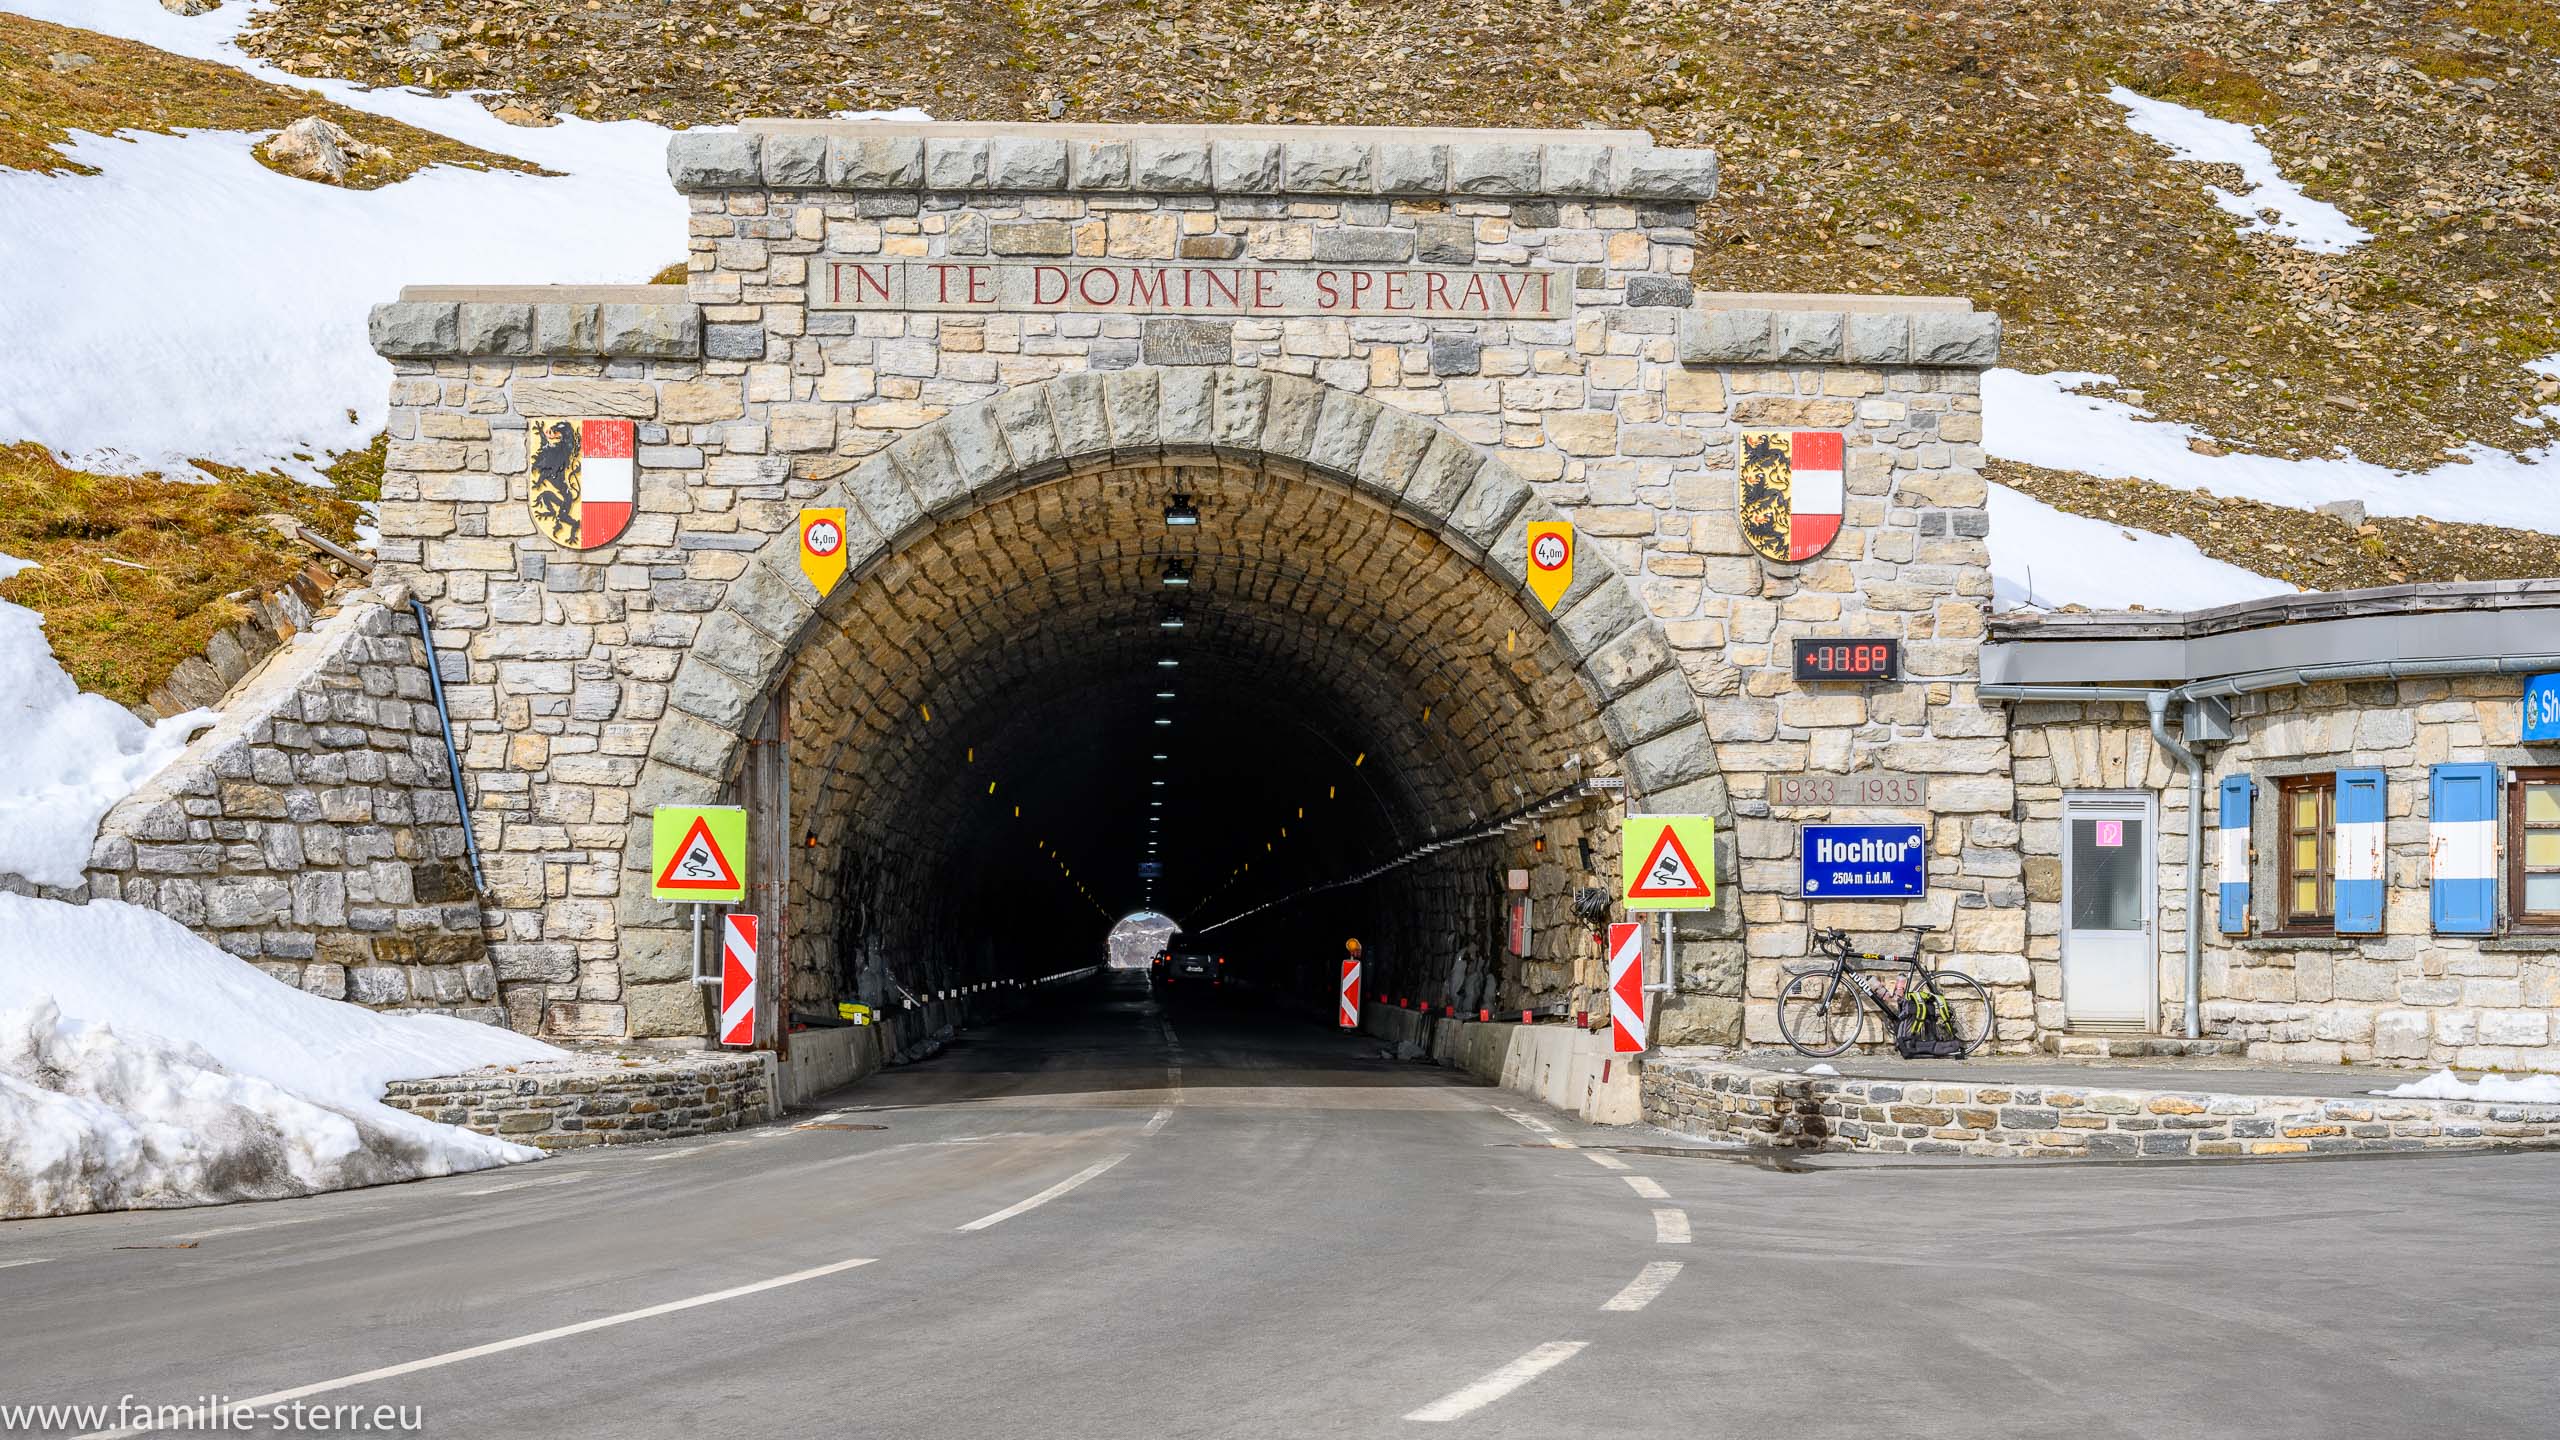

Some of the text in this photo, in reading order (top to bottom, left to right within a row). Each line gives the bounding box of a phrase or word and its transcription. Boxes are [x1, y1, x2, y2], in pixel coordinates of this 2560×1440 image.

[832, 263, 1552, 313] IN TE DOMINE SPERAVI
[2541, 688, 2560, 724] Sh
[1777, 779, 1834, 803] 1933
[1859, 779, 1918, 803] 1935
[1817, 838, 1908, 863] Hochtor
